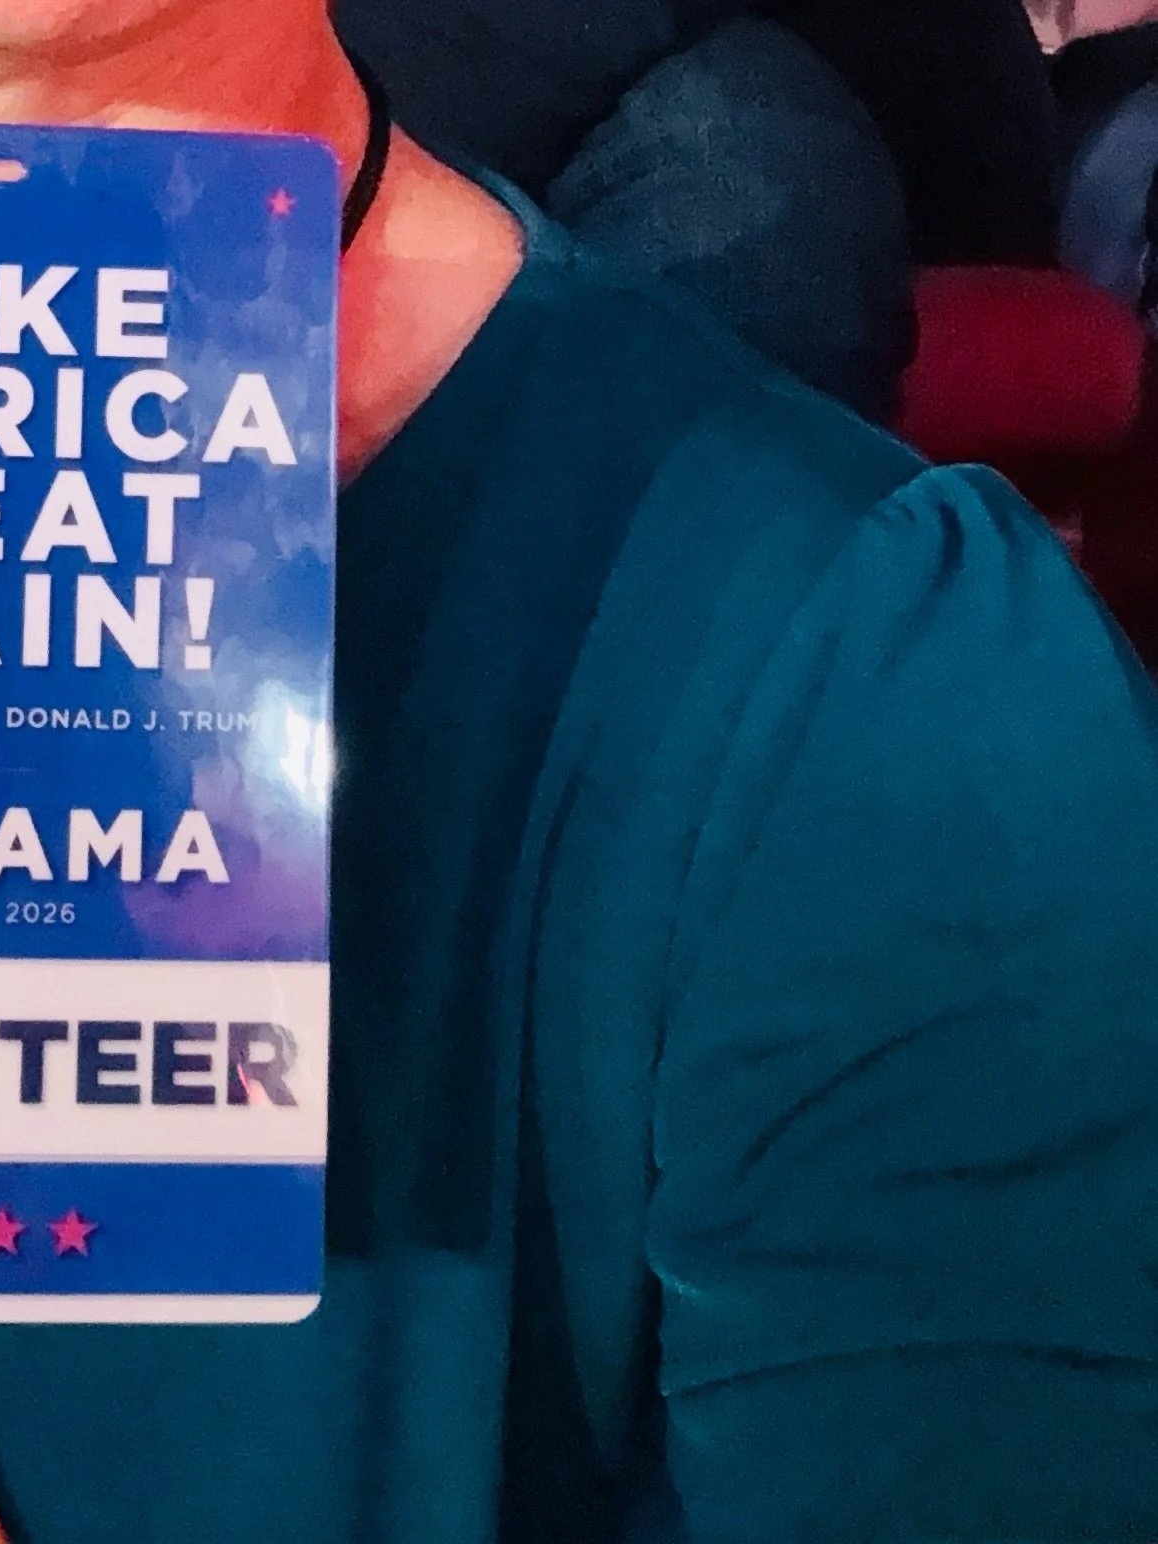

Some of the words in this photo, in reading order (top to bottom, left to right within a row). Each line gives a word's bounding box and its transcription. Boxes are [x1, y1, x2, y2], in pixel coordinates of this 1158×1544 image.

[6, 706, 132, 730] DONALD
[143, 709, 166, 731] J.
[178, 710, 258, 733] TRUM
[5, 901, 76, 924] 2026
